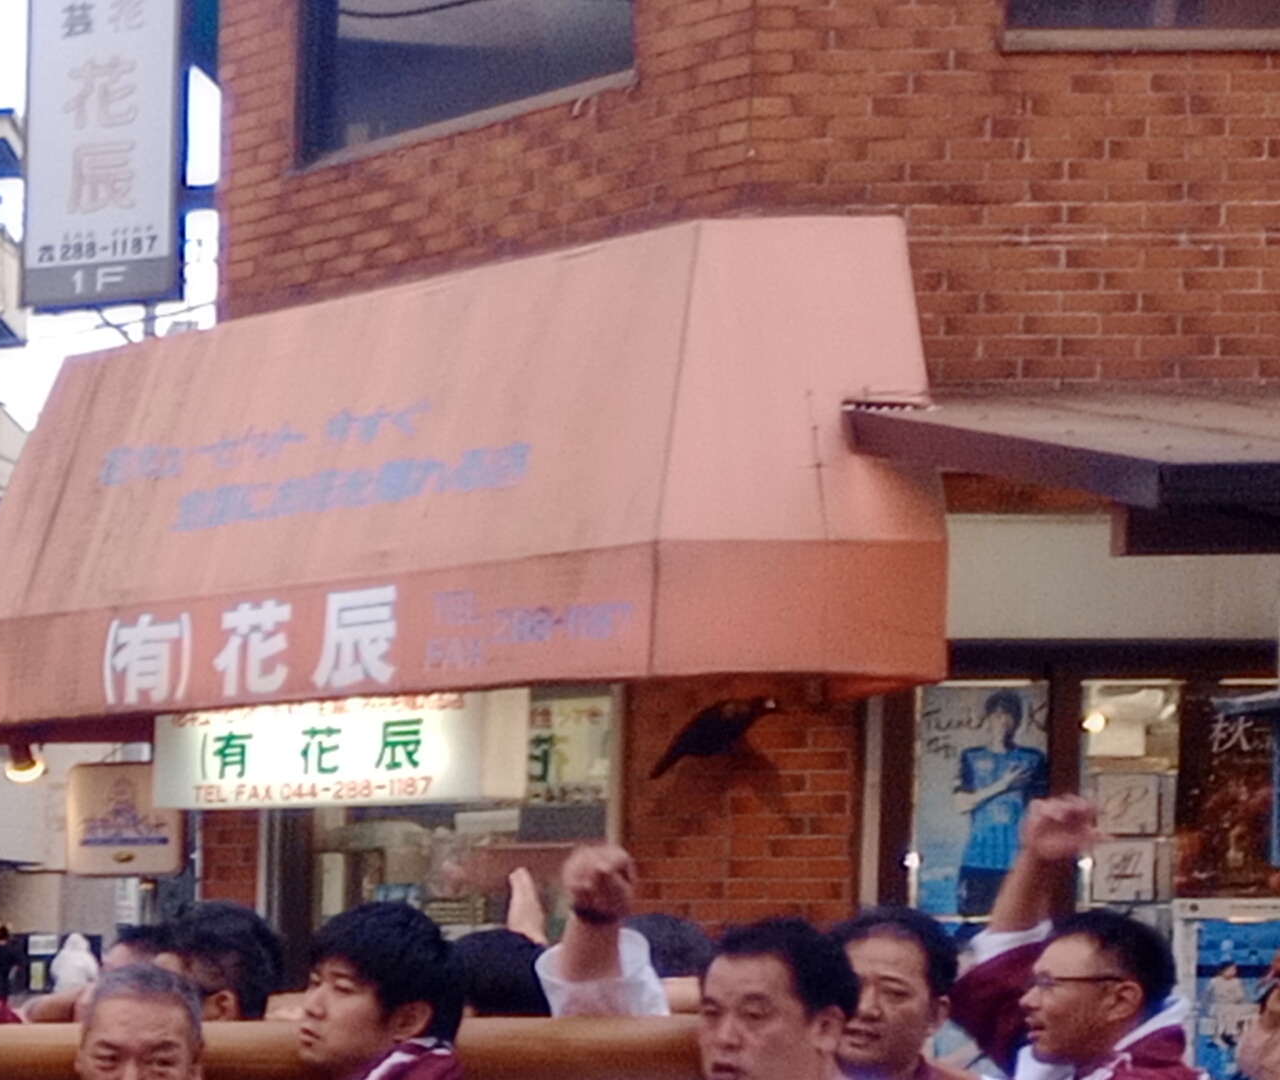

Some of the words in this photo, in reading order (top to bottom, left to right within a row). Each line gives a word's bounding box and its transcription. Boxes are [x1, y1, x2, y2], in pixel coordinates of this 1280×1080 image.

[61, 53, 139, 216] 花辰
[60, 235, 158, 262] 288-1187
[279, 776, 433, 800] 044-288-1187
